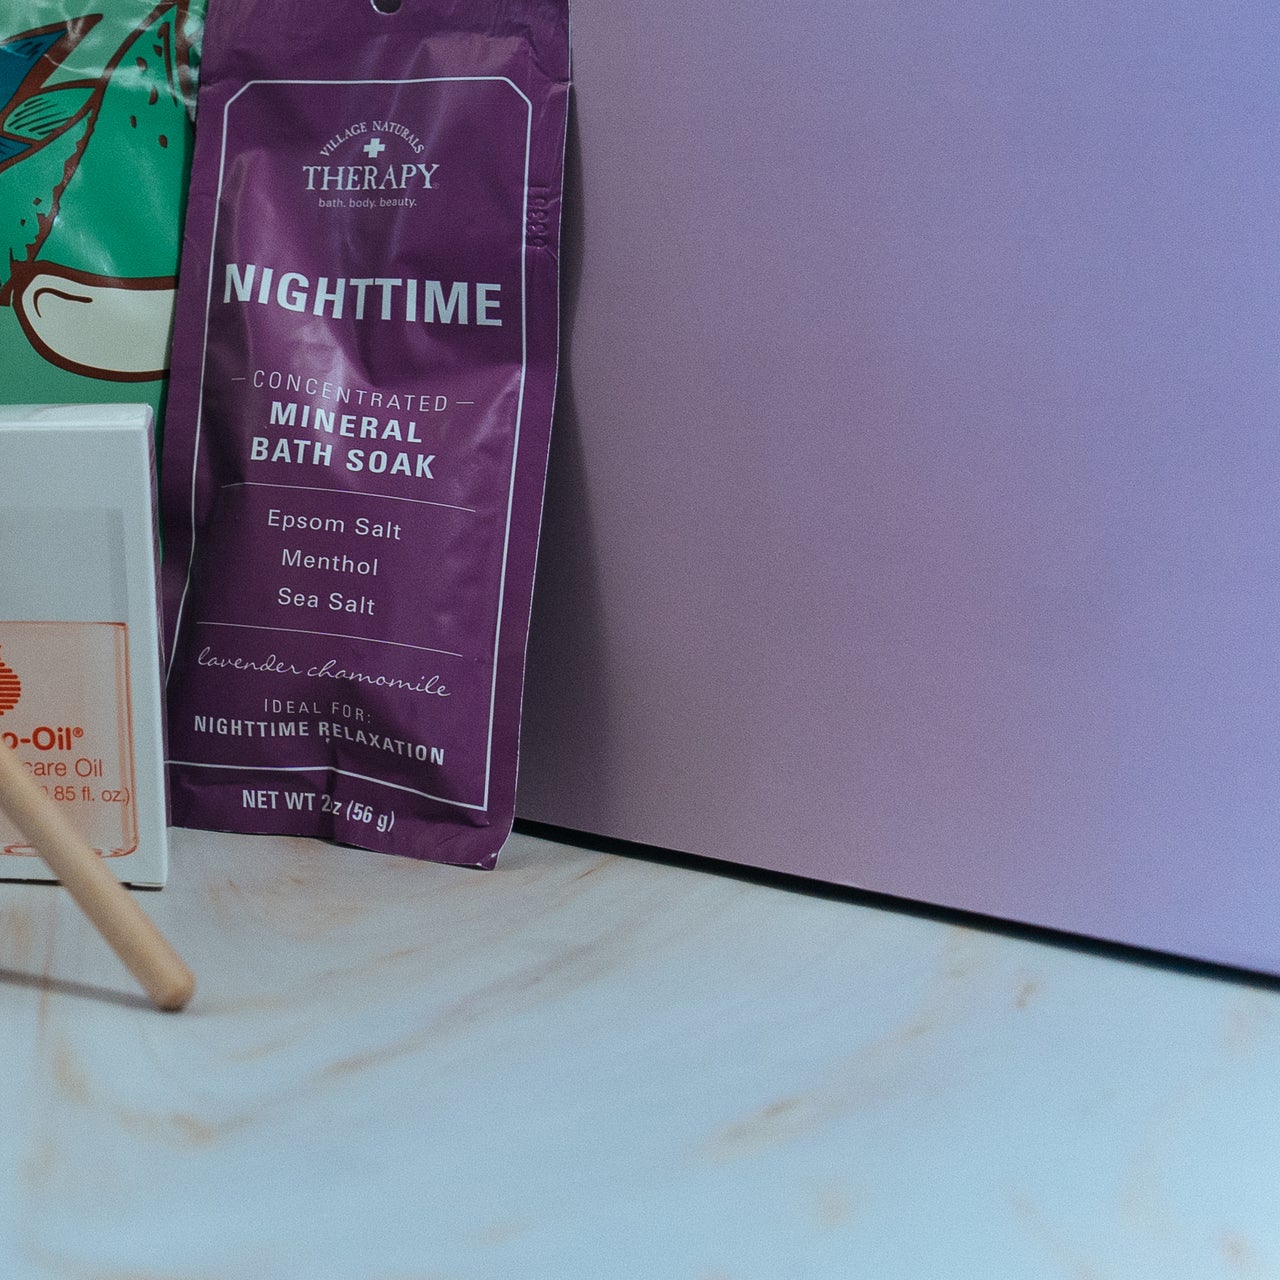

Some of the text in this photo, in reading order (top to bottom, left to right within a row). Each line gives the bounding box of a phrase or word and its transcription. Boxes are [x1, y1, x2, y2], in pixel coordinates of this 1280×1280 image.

[319, 120, 425, 158] VILLAGE NATURALS
[302, 163, 440, 191] THERAPY
[318, 197, 418, 210] bath. body. beauty.
[223, 263, 503, 327] NIGHTTIME
[252, 368, 449, 412] CONCENTRATED
[269, 400, 424, 443] MINERAL
[249, 436, 436, 480] BATH SOAK
[267, 508, 402, 541] Epsom Salt
[281, 548, 379, 576] Menthol
[277, 587, 376, 616] Sea Salt
[197, 646, 452, 699] lavender chamomile
[263, 698, 372, 724] IDEAL FOR:
[193, 715, 446, 767] NIGHTTIME RELAXATION
[74, 758, 104, 777] Oil
[82, 785, 96, 802] fl.
[242, 789, 279, 810] NET
[284, 791, 317, 811] WT
[346, 799, 375, 824] (56
[376, 810, 396, 833] g)
